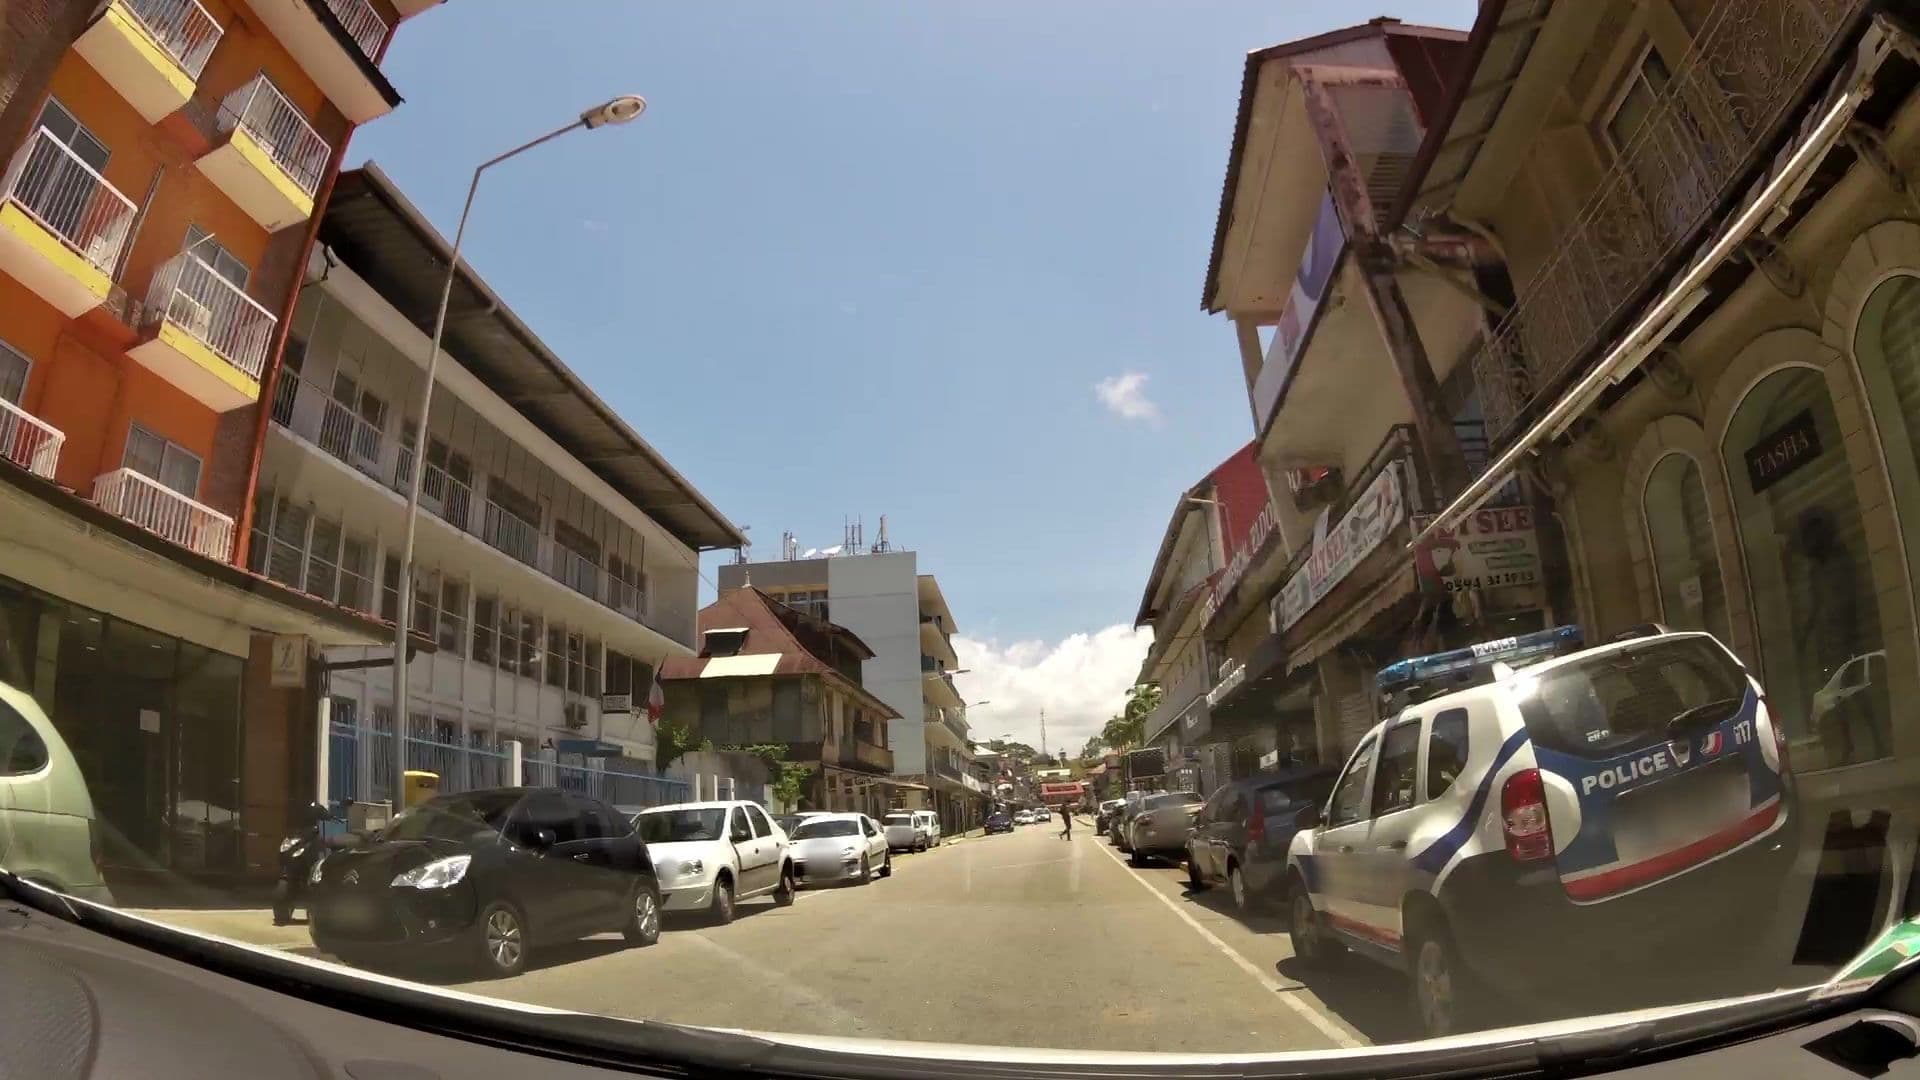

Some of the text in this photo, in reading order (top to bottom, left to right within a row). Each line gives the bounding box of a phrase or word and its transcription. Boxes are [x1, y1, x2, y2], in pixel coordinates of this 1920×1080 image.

[1753, 427, 1809, 478] TASHA
[1472, 637, 1517, 657] POLICE
[1581, 751, 1669, 795] POLICE
